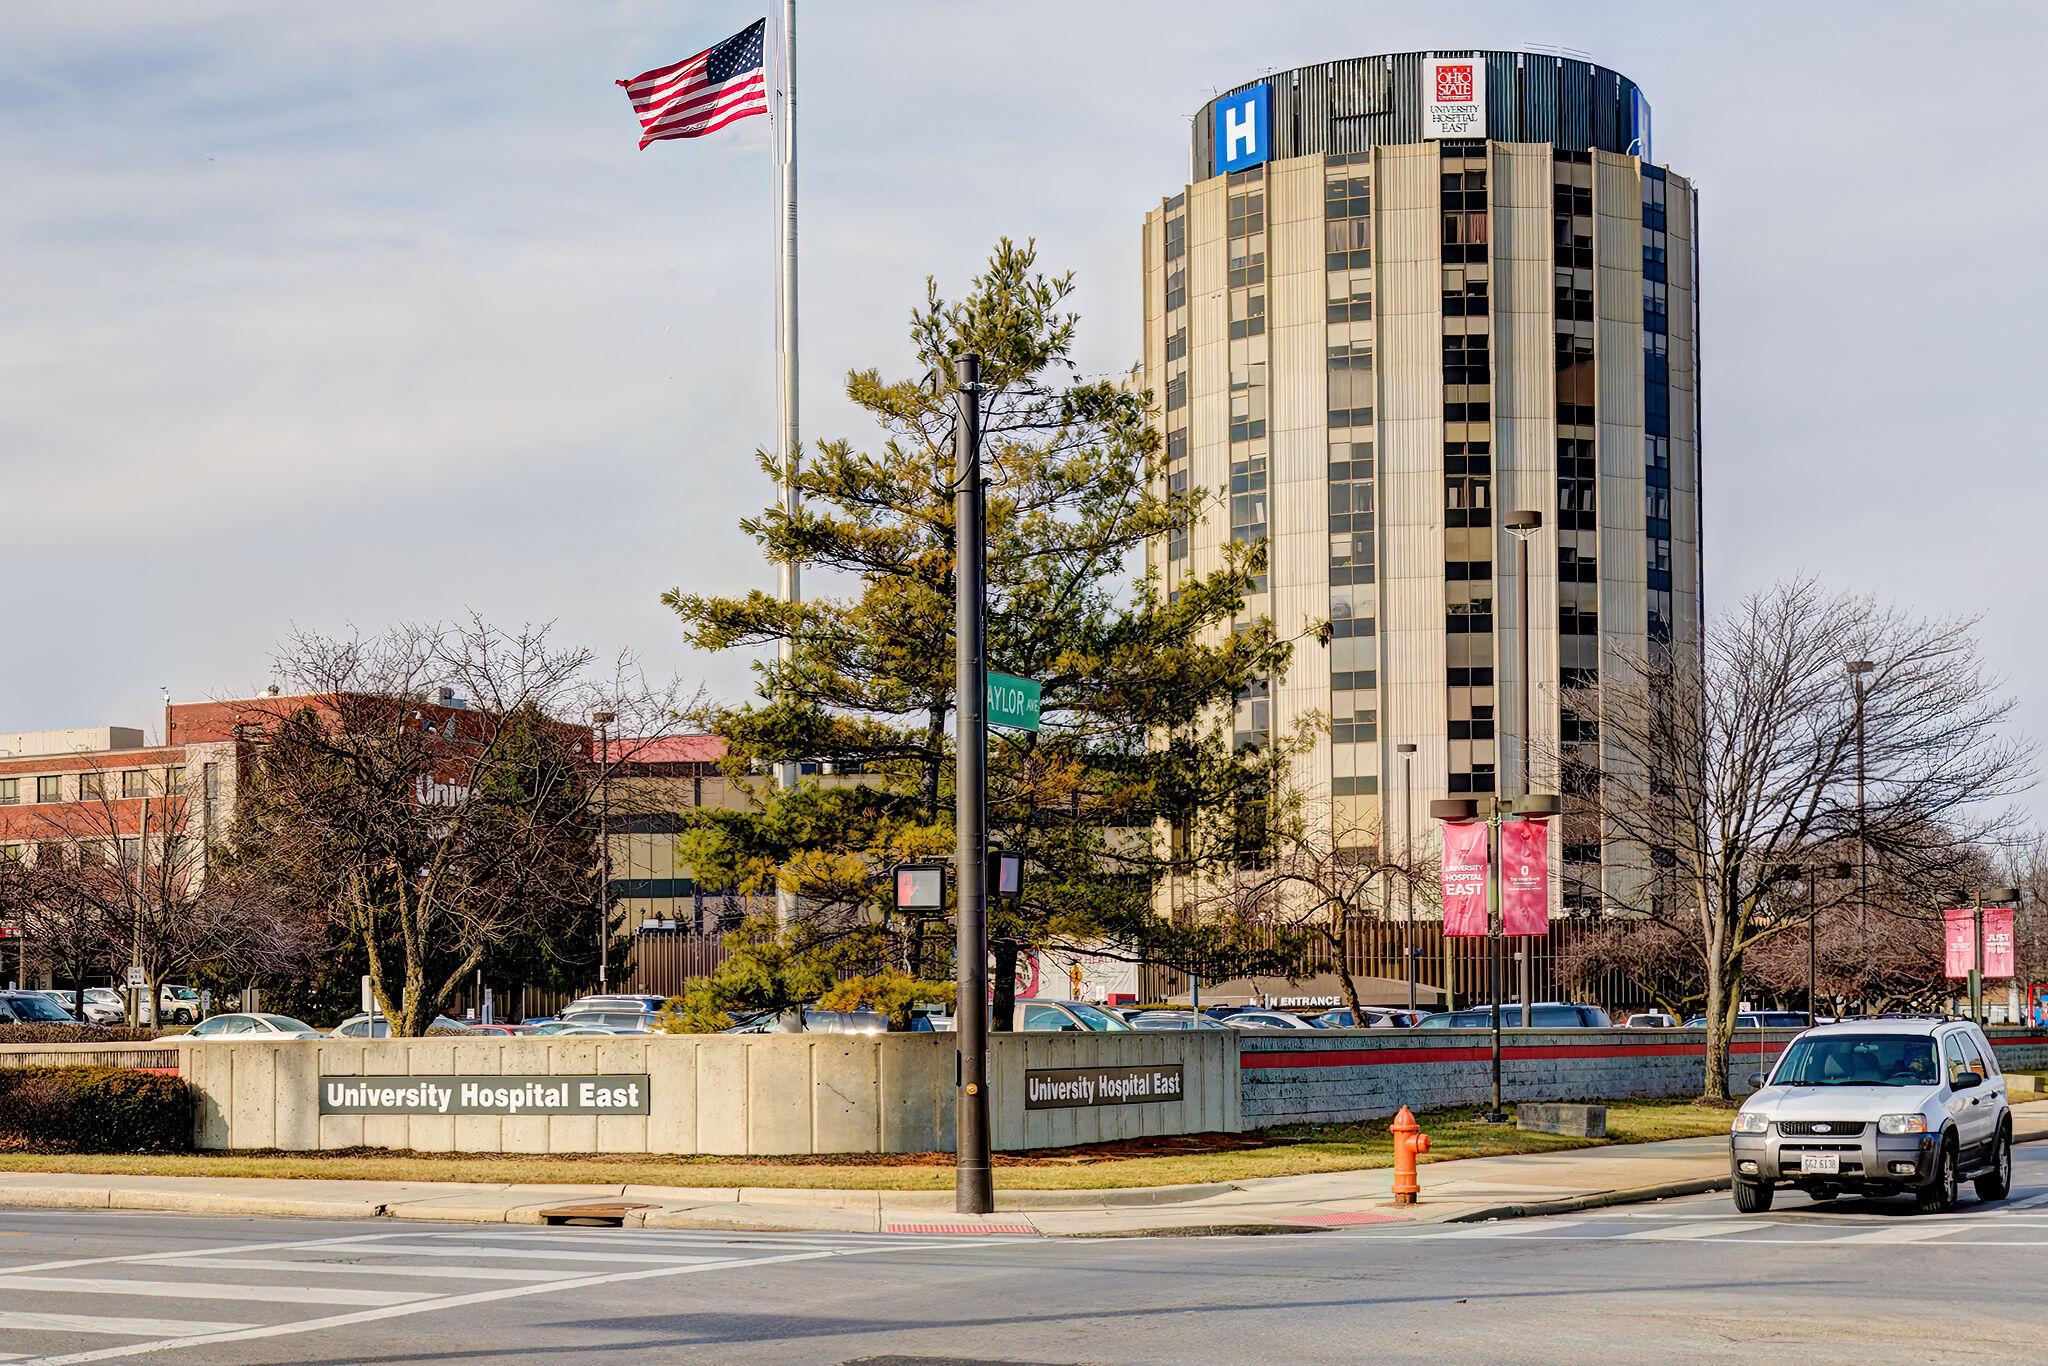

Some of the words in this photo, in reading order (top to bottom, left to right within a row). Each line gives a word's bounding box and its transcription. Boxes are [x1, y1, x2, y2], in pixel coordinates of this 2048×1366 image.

[1438, 72, 1472, 84] OHIO
[1438, 84, 1472, 95] STATE
[1430, 105, 1480, 113] UNIVERSITY
[1432, 114, 1478, 122] HOSPITAL
[1226, 100, 1255, 162] H
[1442, 123, 1469, 132] EAST
[987, 685, 1024, 716] AYLOR
[1445, 873, 1483, 882] HOSPITAL
[1445, 883, 1484, 896] EAST
[1281, 996, 1341, 1007] ENTRANCE
[1029, 1076, 1095, 1104] University
[1099, 1073, 1149, 1102] Hospital
[1153, 1072, 1180, 1094] East
[327, 1083, 452, 1112] University
[461, 1083, 568, 1113] Hospital
[579, 1083, 639, 1107] East
